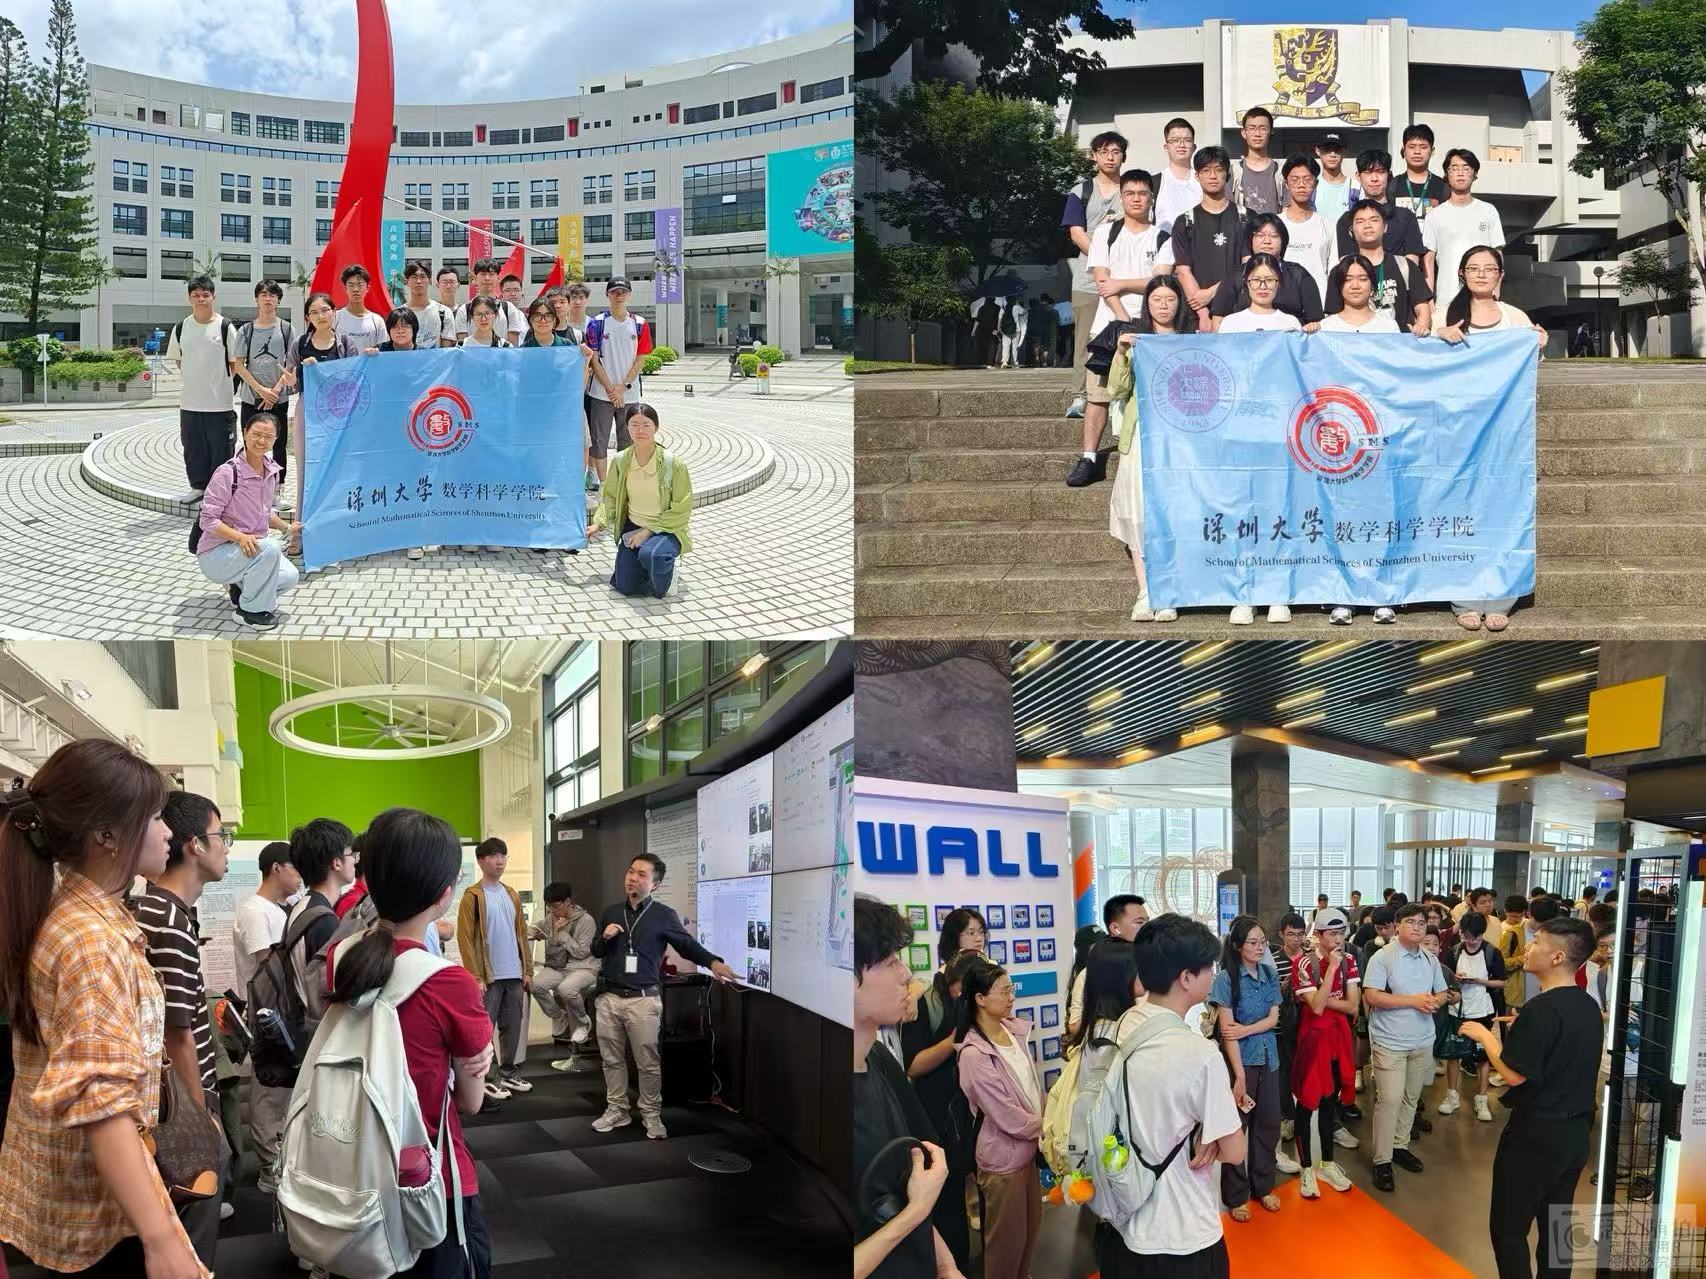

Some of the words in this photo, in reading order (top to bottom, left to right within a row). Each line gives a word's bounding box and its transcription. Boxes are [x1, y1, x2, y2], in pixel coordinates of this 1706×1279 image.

[669, 215, 677, 248] HAPPEN
[1357, 436, 1390, 447] SMS
[442, 481, 546, 502] 数学科学学院
[348, 519, 372, 529] School
[372, 517, 380, 526] of
[381, 510, 430, 524] Mathematical
[431, 509, 461, 519] Sciences
[462, 509, 470, 517] of
[507, 510, 546, 522] University
[1335, 515, 1475, 543] 数学科学学院
[1205, 557, 1237, 567] School
[1239, 557, 1250, 567] of
[1251, 555, 1320, 567] Mathematical
[1322, 555, 1361, 568] Sciences
[1362, 557, 1374, 568] of
[1375, 554, 1421, 567] Shenzhen
[1423, 552, 1476, 563] University
[857, 821, 1059, 877] WALL
